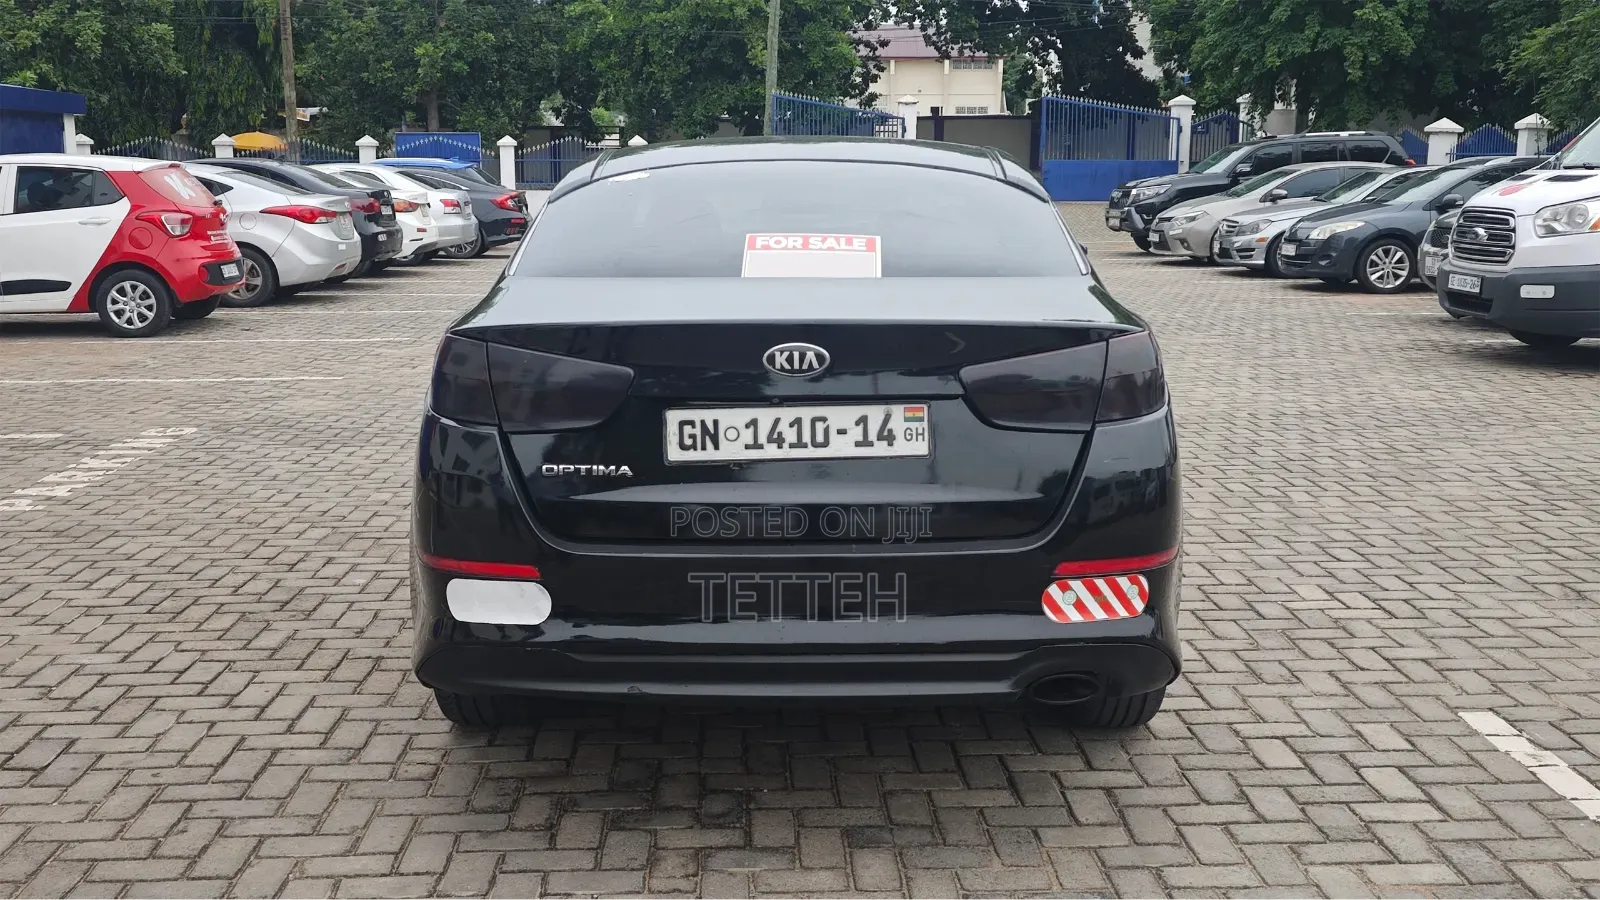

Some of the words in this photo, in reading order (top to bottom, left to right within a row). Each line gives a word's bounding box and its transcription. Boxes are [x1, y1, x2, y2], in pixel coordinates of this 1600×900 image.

[755, 236, 803, 249] FOR
[808, 237, 867, 250] SALE
[774, 351, 820, 370] KIA
[678, 418, 720, 451] GN
[744, 412, 896, 450] 1410-14
[904, 426, 926, 442] GH
[541, 464, 634, 478] OPTIMA
